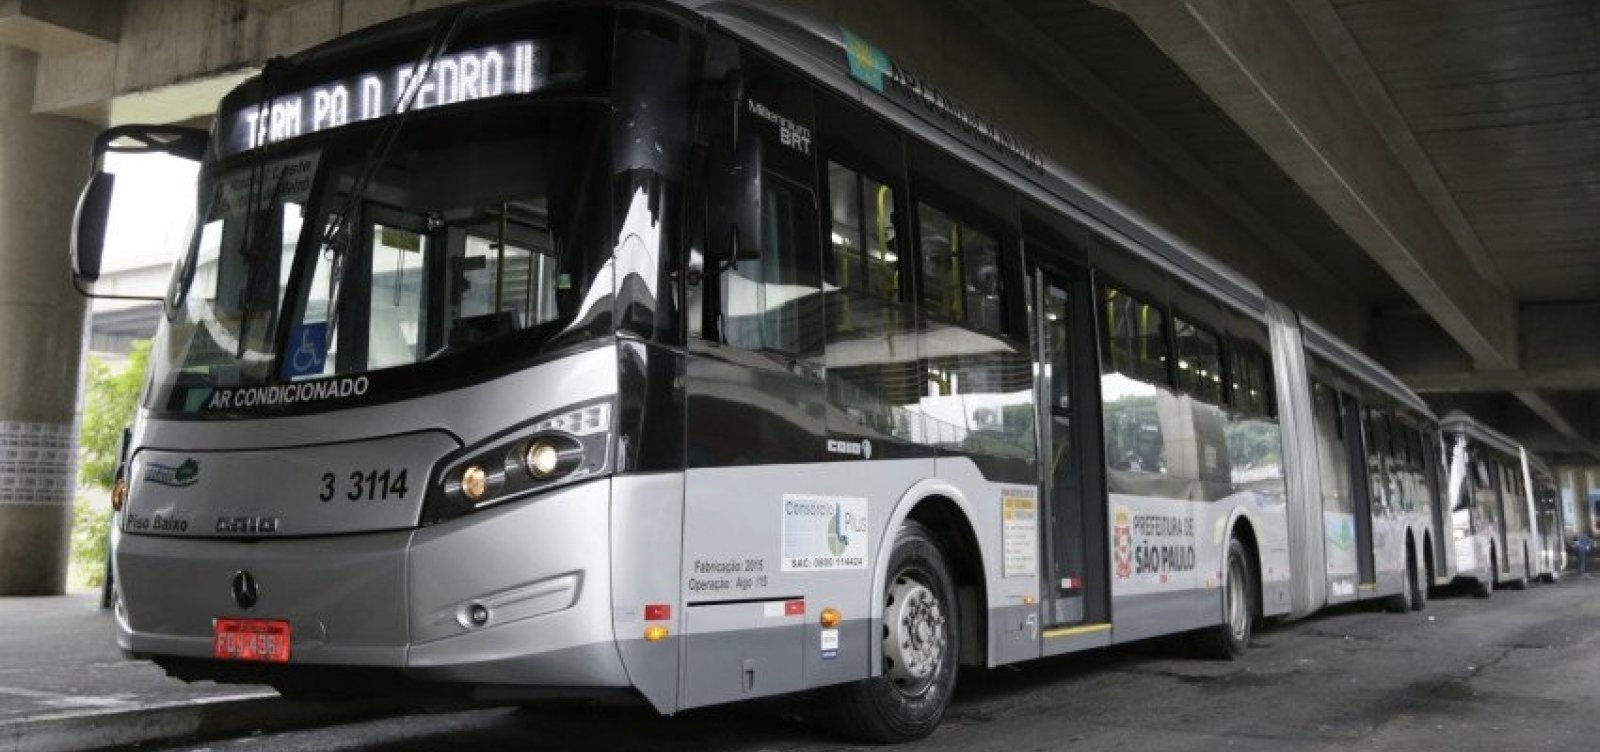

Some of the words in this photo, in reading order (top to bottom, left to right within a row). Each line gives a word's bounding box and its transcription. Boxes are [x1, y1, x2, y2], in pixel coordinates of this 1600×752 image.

[397, 50, 503, 114] PEDRO
[515, 43, 533, 94] II
[780, 126, 811, 153] BRT
[208, 390, 233, 408] AR
[234, 376, 369, 407] CONDICIONADO
[320, 472, 336, 502] 3
[347, 468, 408, 502] 3114
[1133, 514, 1182, 536] PREFEITURA
[1134, 539, 1160, 574] SÃO
[1161, 546, 1196, 573] PAULO
